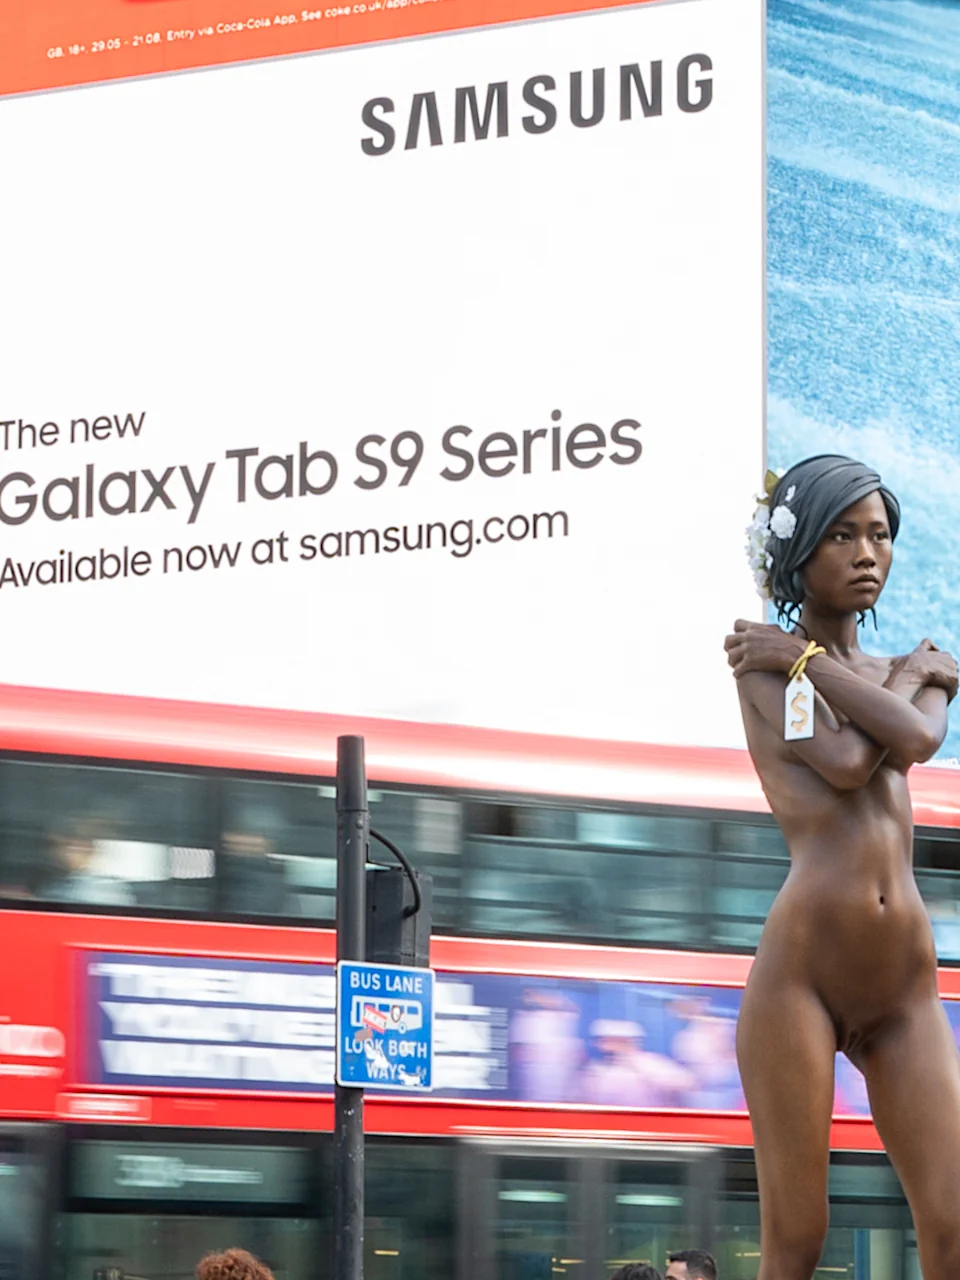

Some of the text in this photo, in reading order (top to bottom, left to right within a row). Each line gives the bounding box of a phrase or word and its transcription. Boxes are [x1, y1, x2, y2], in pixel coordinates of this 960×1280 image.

[166, 29, 195, 42] Entry
[197, 25, 214, 36] via
[216, 18, 271, 34] Coca-Cola
[301, 9, 322, 22] See
[360, 56, 714, 156] SAMSUNG
[0, 412, 146, 450] The new
[0, 410, 643, 524] Galaxy Tab S9 Series
[0, 508, 569, 589] Available now at samsung.com
[350, 971, 423, 994] BUS LANE
[366, 1062, 406, 1080] WAYS
